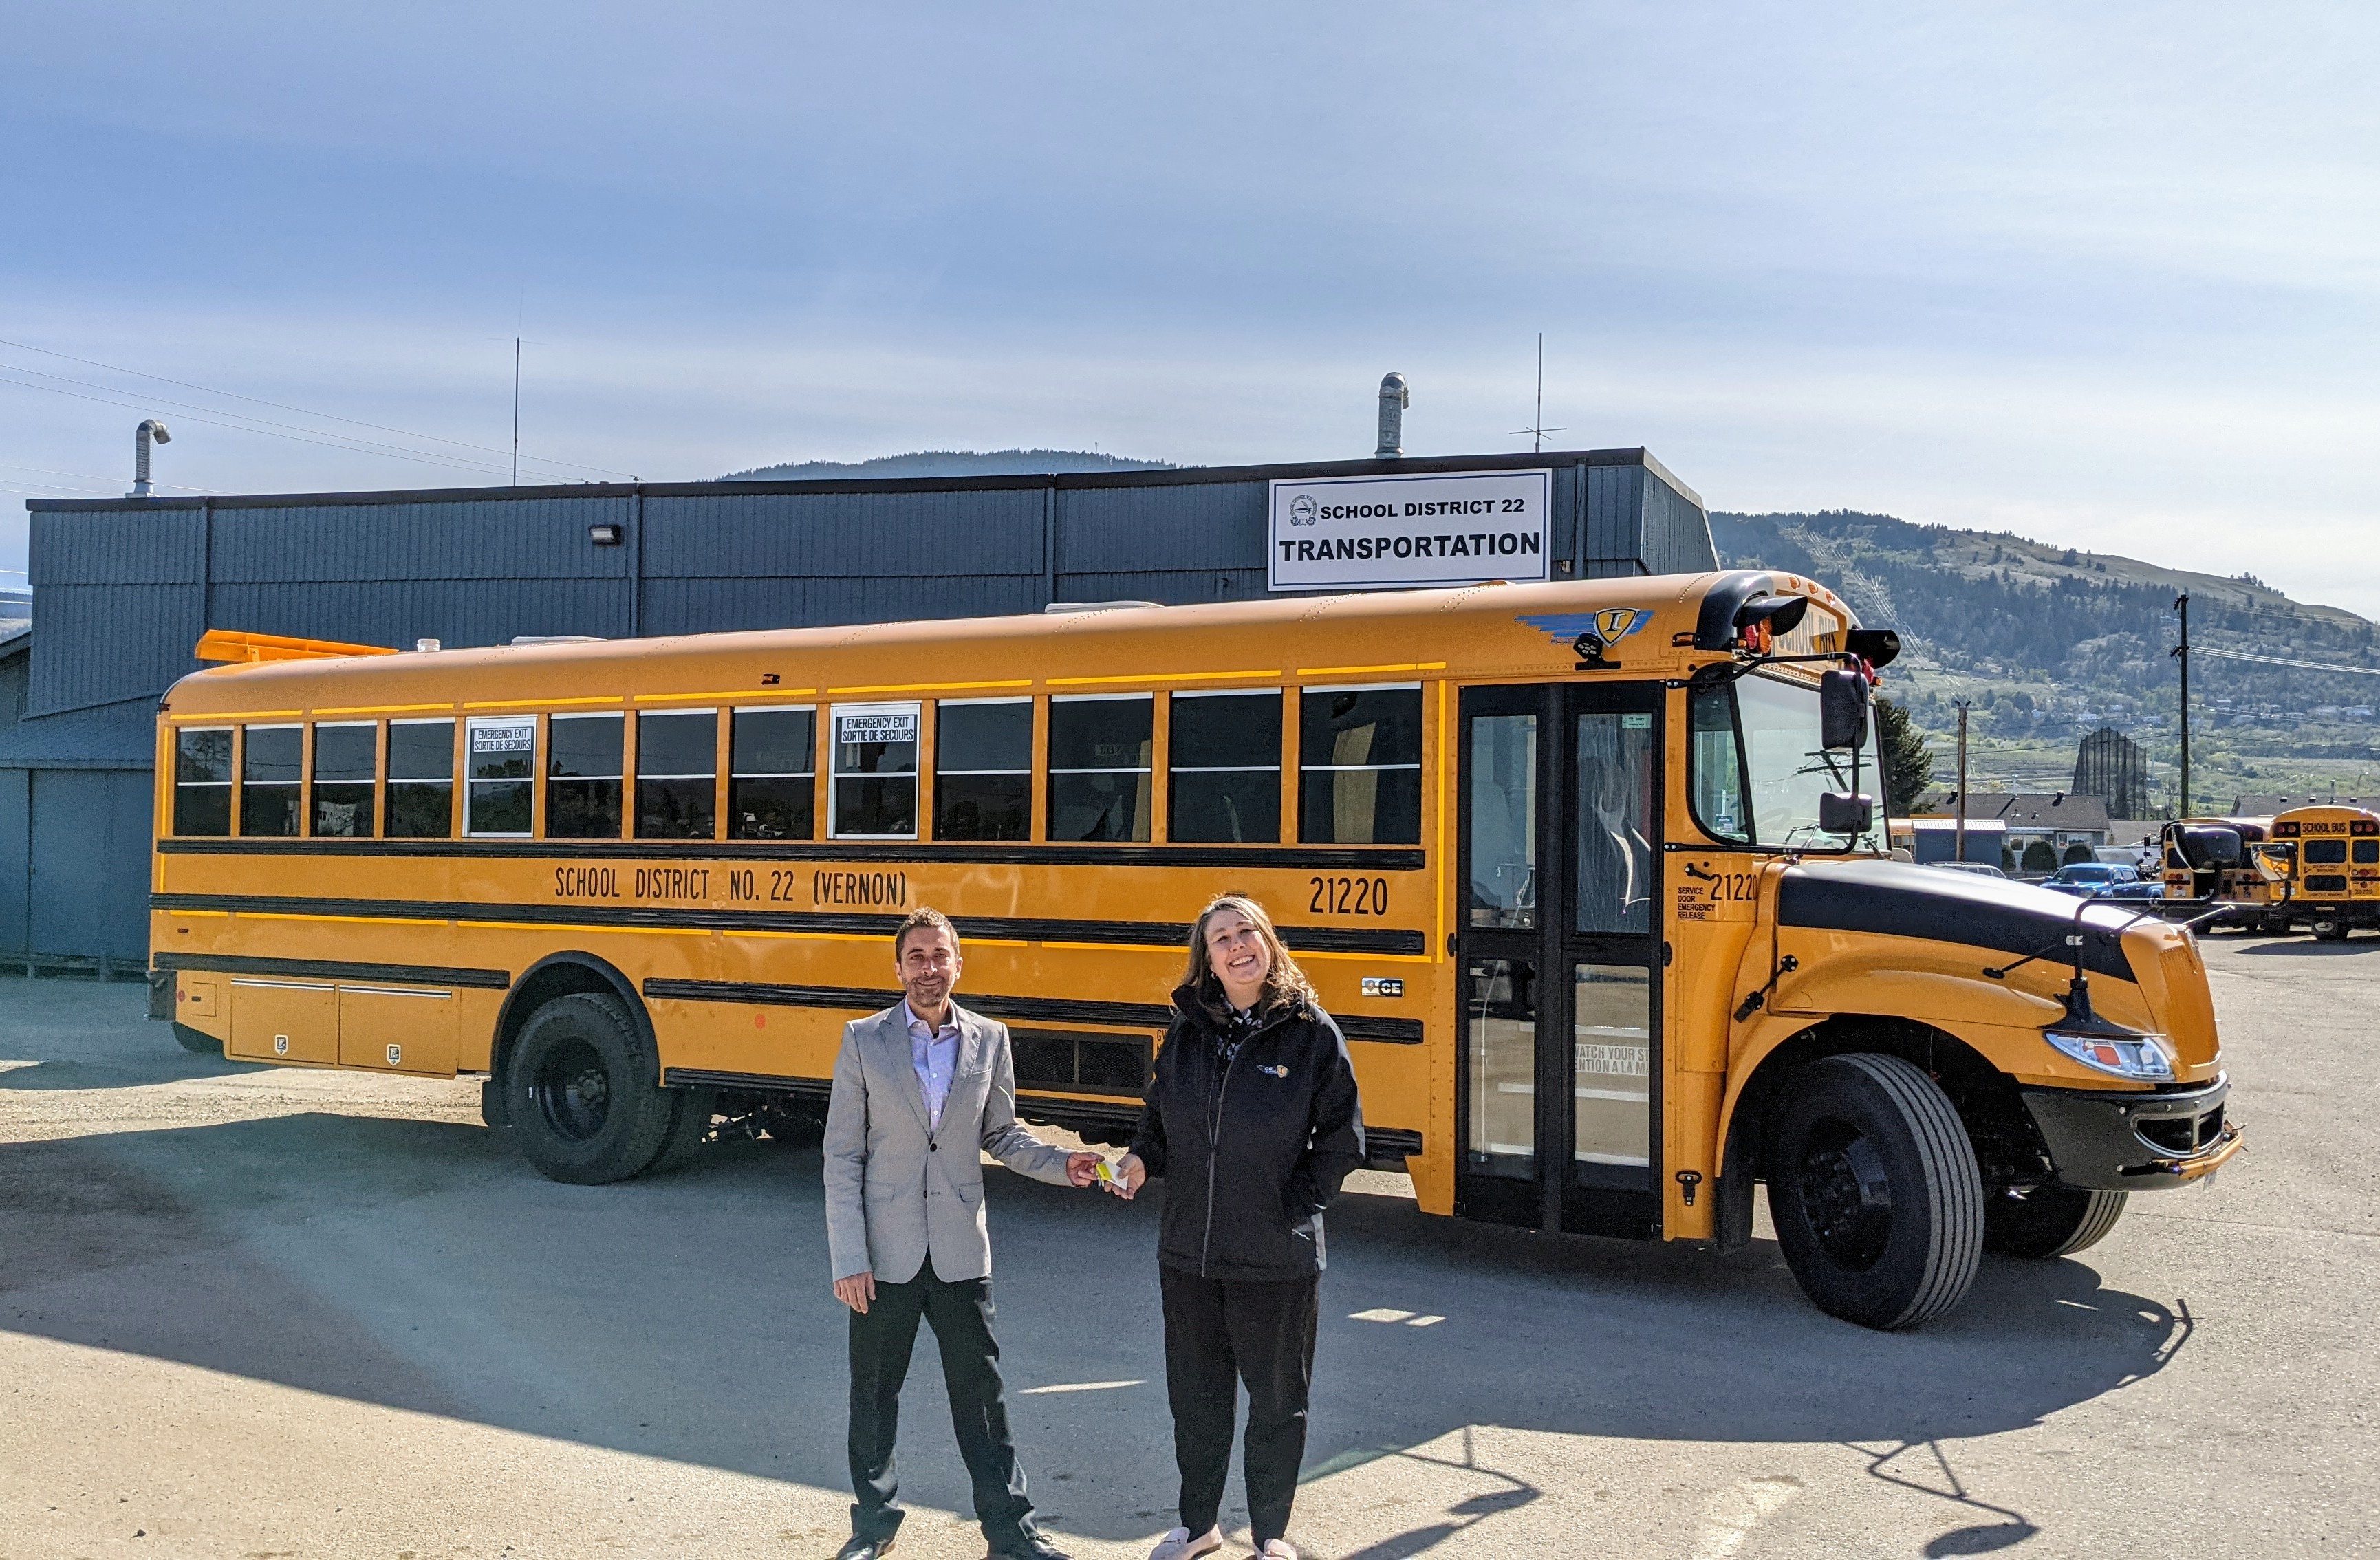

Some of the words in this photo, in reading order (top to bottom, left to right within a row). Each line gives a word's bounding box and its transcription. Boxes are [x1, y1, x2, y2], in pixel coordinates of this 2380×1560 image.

[1320, 504, 1398, 519] SCHOOL
[1405, 500, 1495, 516] DISTRICT
[1501, 499, 1524, 513] 22
[1279, 532, 1539, 561] TRANSPORTATION
[847, 717, 891, 729] EMERGENCY
[893, 717, 909, 728] EXIT
[478, 729, 513, 739] EMERGENCY
[515, 728, 528, 738] EXIT
[843, 730, 867, 741] SORTIE
[869, 730, 878, 741] DE
[880, 728, 913, 741] SECOURS
[475, 740, 495, 750] SORTIE
[496, 740, 504, 750] DE
[504, 739, 530, 750] SECOURS
[2302, 823, 2330, 832] SCHOOL
[2332, 822, 2346, 832] BUS
[556, 867, 620, 897] SCHOOL
[636, 868, 710, 899] DISTRICT
[730, 869, 760, 901] NO.
[770, 869, 794, 901] 22
[814, 869, 906, 908] (VERNON)
[1678, 887, 1704, 895] SERVICE
[1310, 876, 1387, 916] 21220
[1678, 903, 1716, 911] EMERGENCY
[1381, 982, 1401, 994] CE
[1608, 1047, 1635, 1061] YOUR
